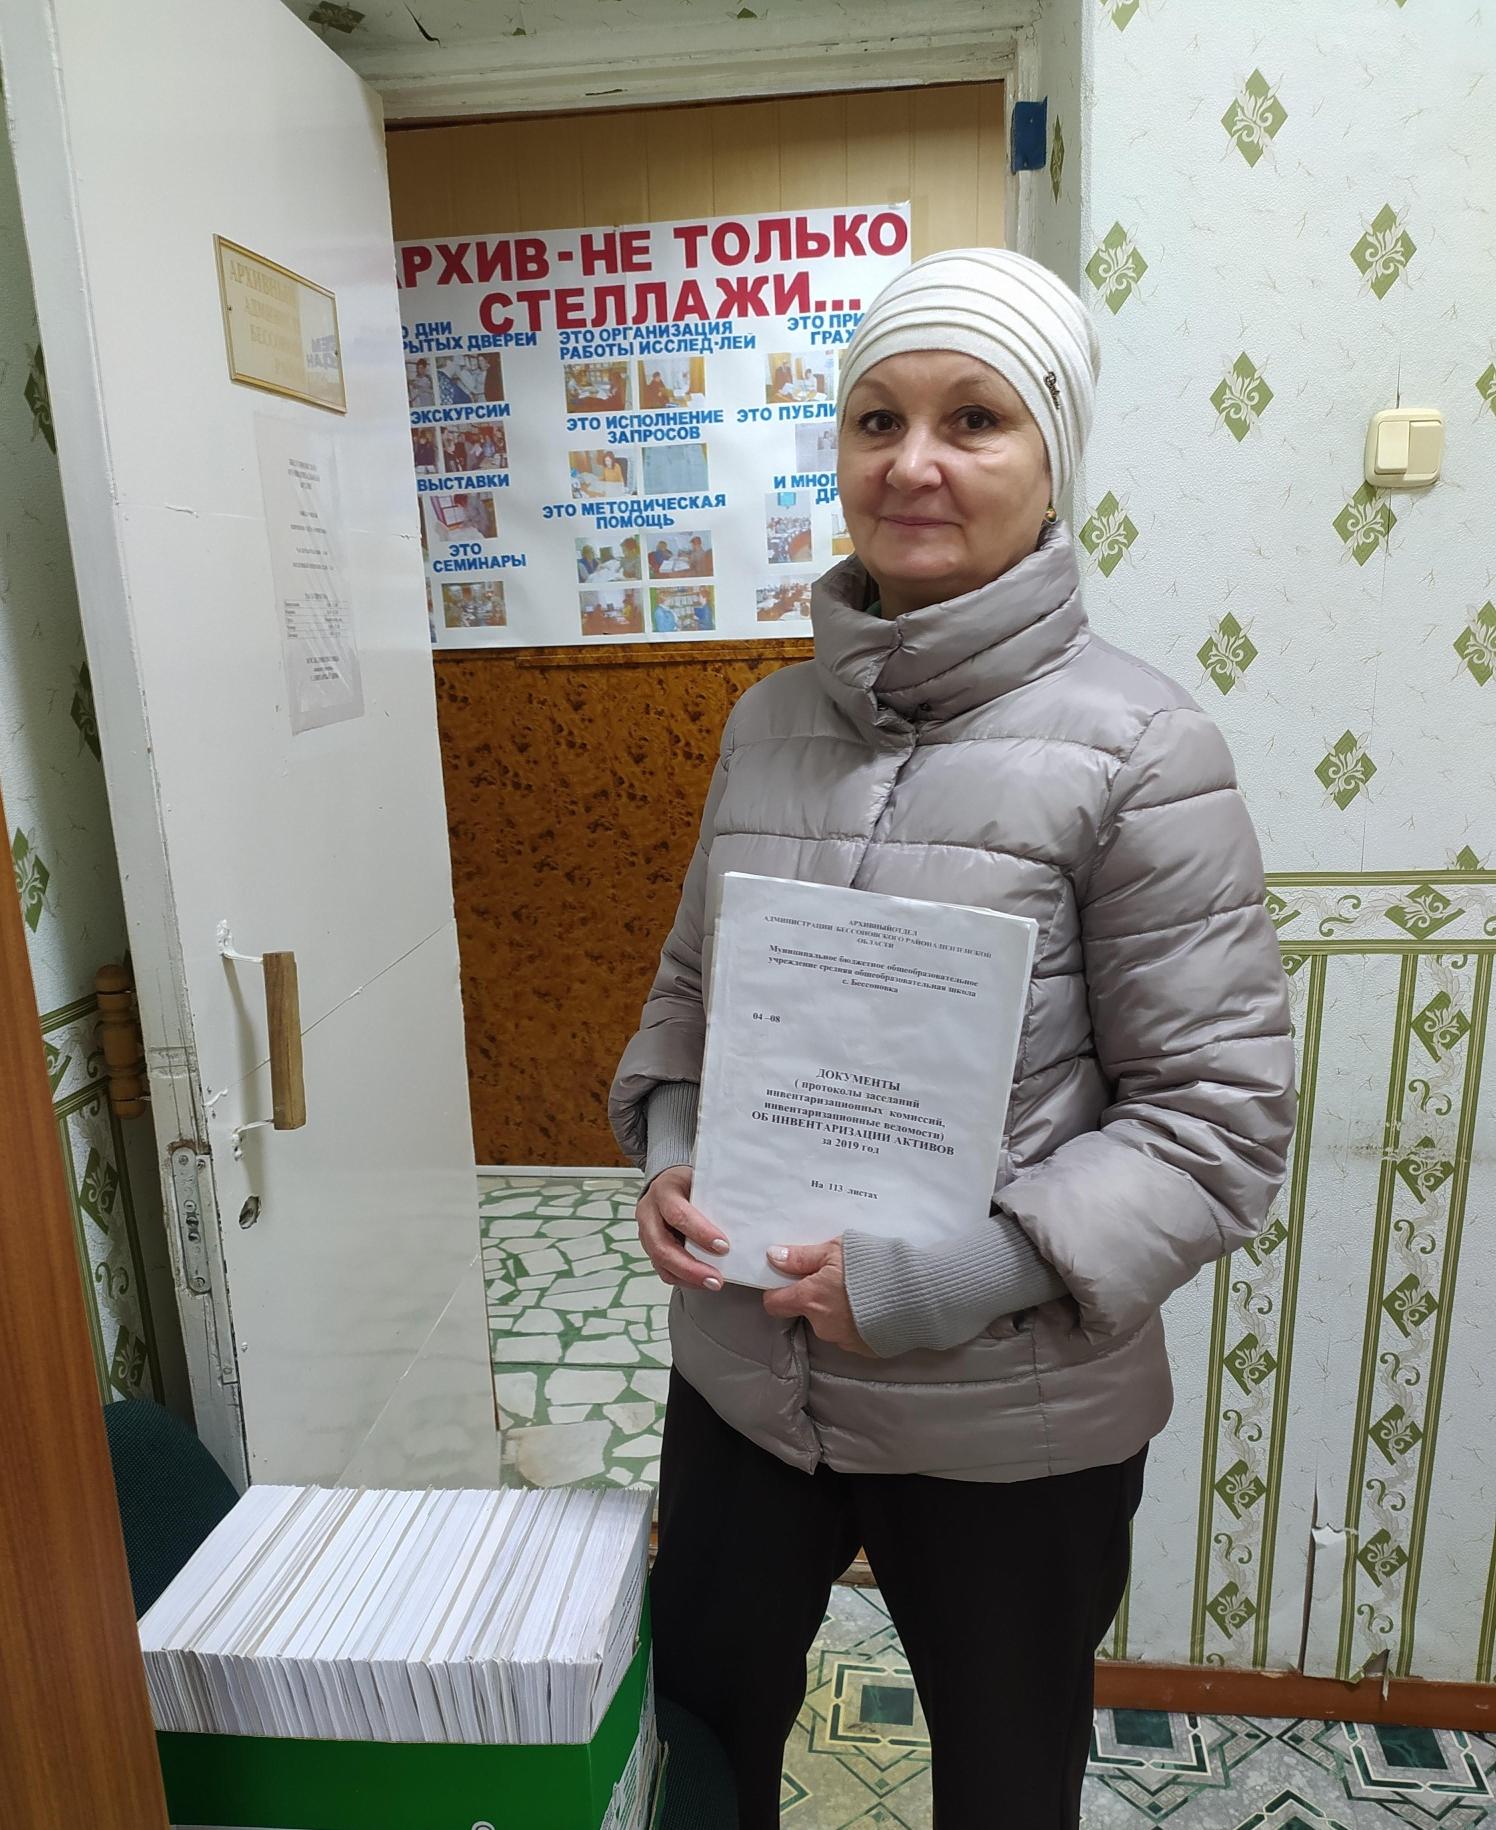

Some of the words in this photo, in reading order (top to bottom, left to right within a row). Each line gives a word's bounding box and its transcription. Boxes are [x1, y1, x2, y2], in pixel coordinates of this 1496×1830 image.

[673, 212, 908, 269] ТОЛЬКО
[479, 271, 862, 335] СТЕЛЛАЖИ...
[415, 321, 452, 340] ДНИ
[559, 330, 595, 346] ЭТО
[600, 320, 733, 343] ОРГАНИЗАЦИЯ
[787, 315, 824, 331] ЭТО
[560, 342, 634, 361] РАБОТЫ
[639, 331, 757, 356] ИССЛЕД-ЛЕЙ
[410, 403, 511, 425] ЭКСКУРСИИ
[566, 416, 600, 432] ЭТО
[606, 410, 724, 430] ИСПОЛНЕНИЕ
[737, 407, 772, 423] ЭТО
[608, 426, 700, 444] ЗАПРОСОВ
[417, 474, 510, 492] ВЫСТАВКИ
[774, 475, 786, 489] И
[543, 503, 576, 519] ЭТО
[582, 494, 726, 517] МЕТОДИЧЕСКАЯ
[596, 514, 674, 530] ПОМОЩЬ
[449, 543, 482, 557] ЭТО
[433, 554, 526, 573] СЕМИНАРЫ
[815, 1068, 901, 1092] ДОКУМЕНТЫ
[766, 1088, 883, 1115] инвентаризационных
[864, 1092, 920, 1108] заседаний
[764, 1101, 881, 1128] инвентаризационные
[751, 1110, 769, 1121] ОБ
[771, 1114, 891, 1143] ИНВЕНТАРИЗАЦИИ
[893, 1136, 955, 1156] АКТИВОВ
[821, 1137, 832, 1146] за
[834, 1138, 860, 1150] 2019
[861, 1144, 880, 1154] год
[811, 1180, 824, 1189] На
[828, 1183, 844, 1193] 113
[847, 1188, 878, 1200] листах
